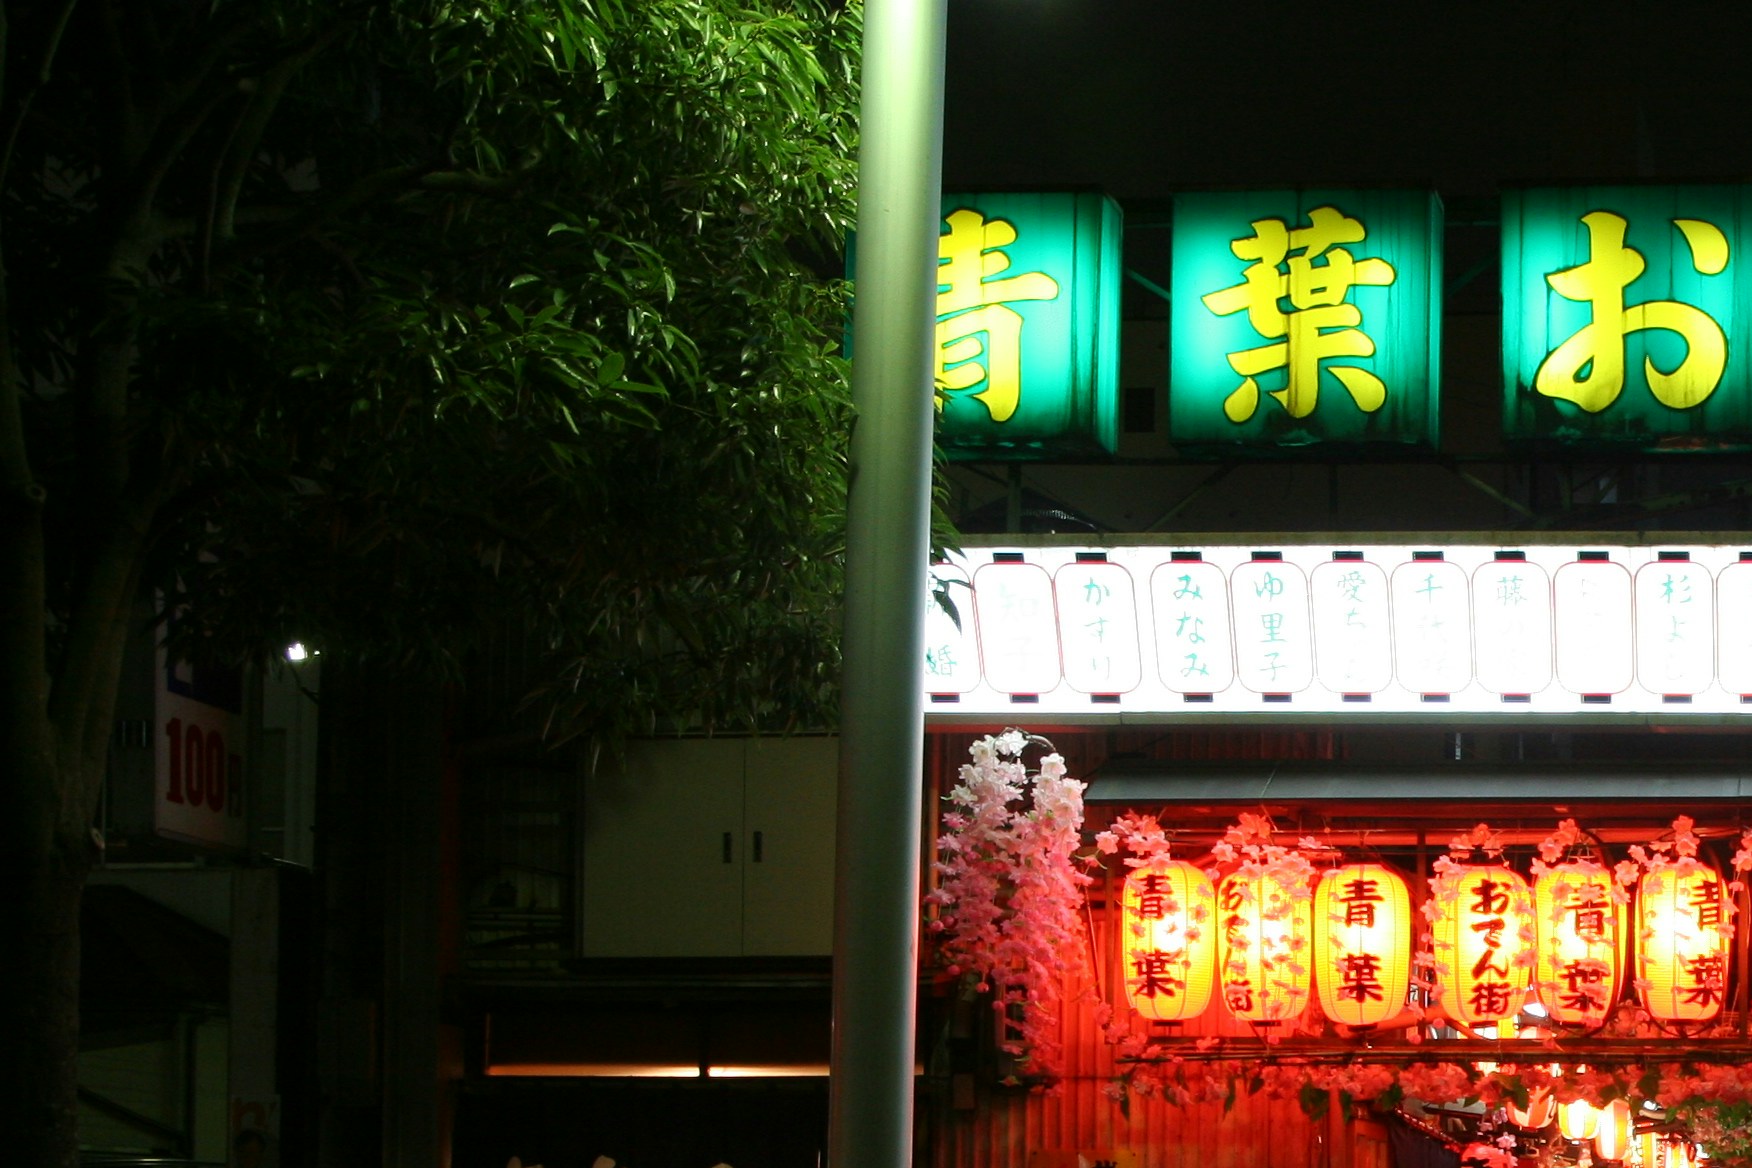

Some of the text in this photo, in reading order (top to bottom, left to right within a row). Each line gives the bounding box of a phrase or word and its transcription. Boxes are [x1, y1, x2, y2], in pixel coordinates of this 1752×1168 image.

[1172, 573, 1211, 678] みなみ
[1252, 571, 1291, 682] ゆ里子
[1337, 879, 1387, 1004] 青葉
[1469, 878, 1512, 1016] おでん街
[1683, 881, 1724, 1009] 青葉
